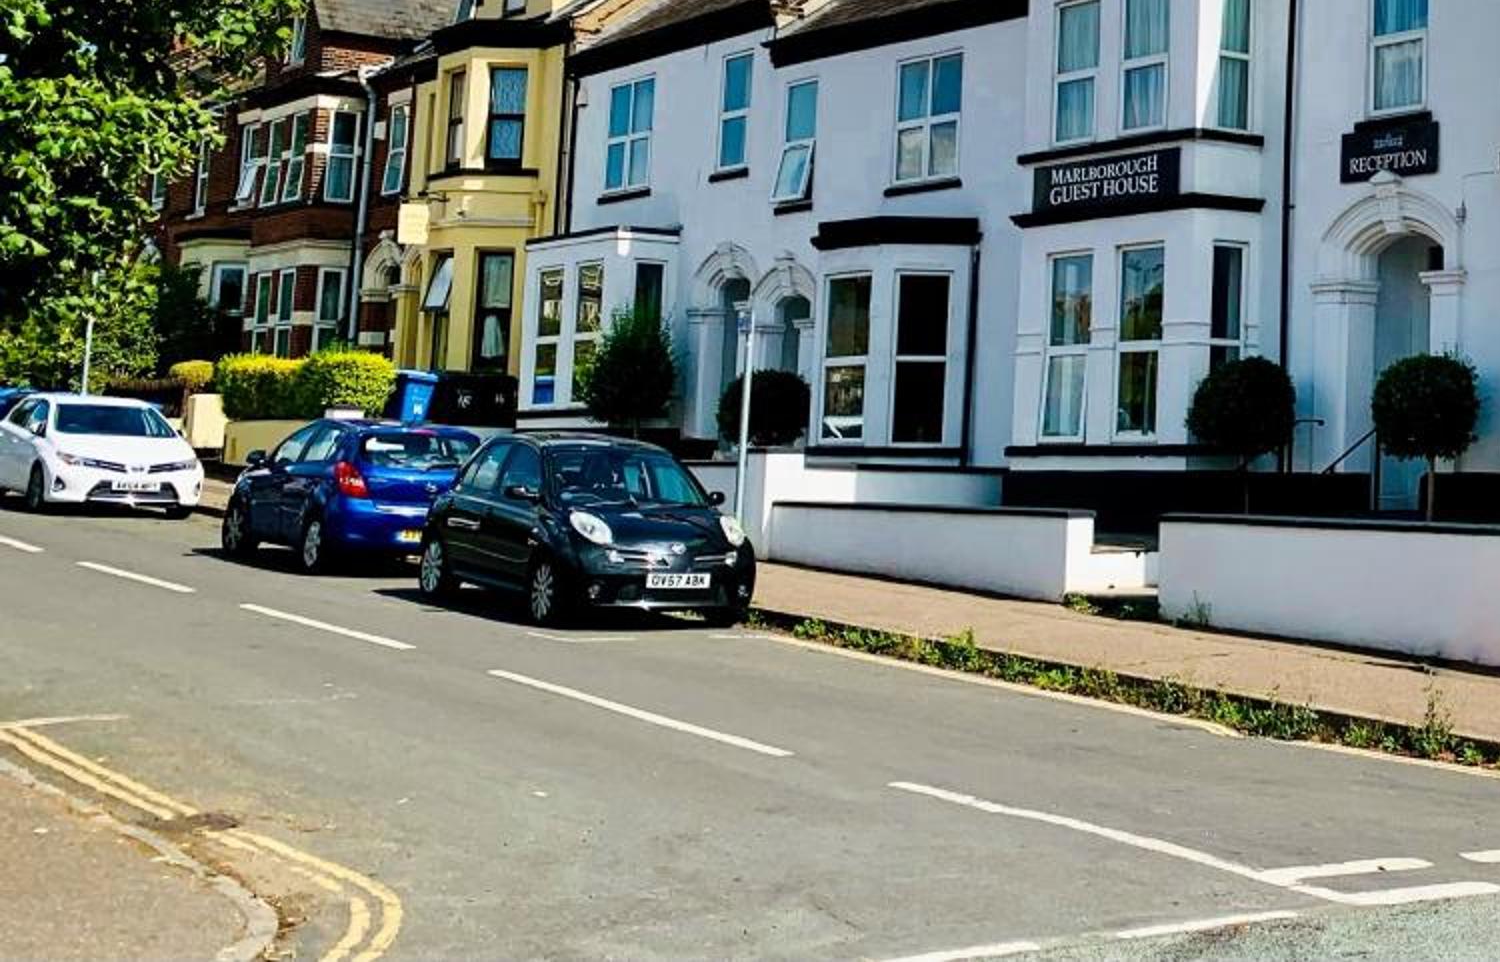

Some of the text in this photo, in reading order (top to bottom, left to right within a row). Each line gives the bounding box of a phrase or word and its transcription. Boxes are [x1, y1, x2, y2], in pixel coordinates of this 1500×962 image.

[1051, 154, 1158, 185] MARLBOROUGH
[1349, 148, 1427, 174] RECEPTION
[1049, 173, 1159, 206] GUEST HOUSE
